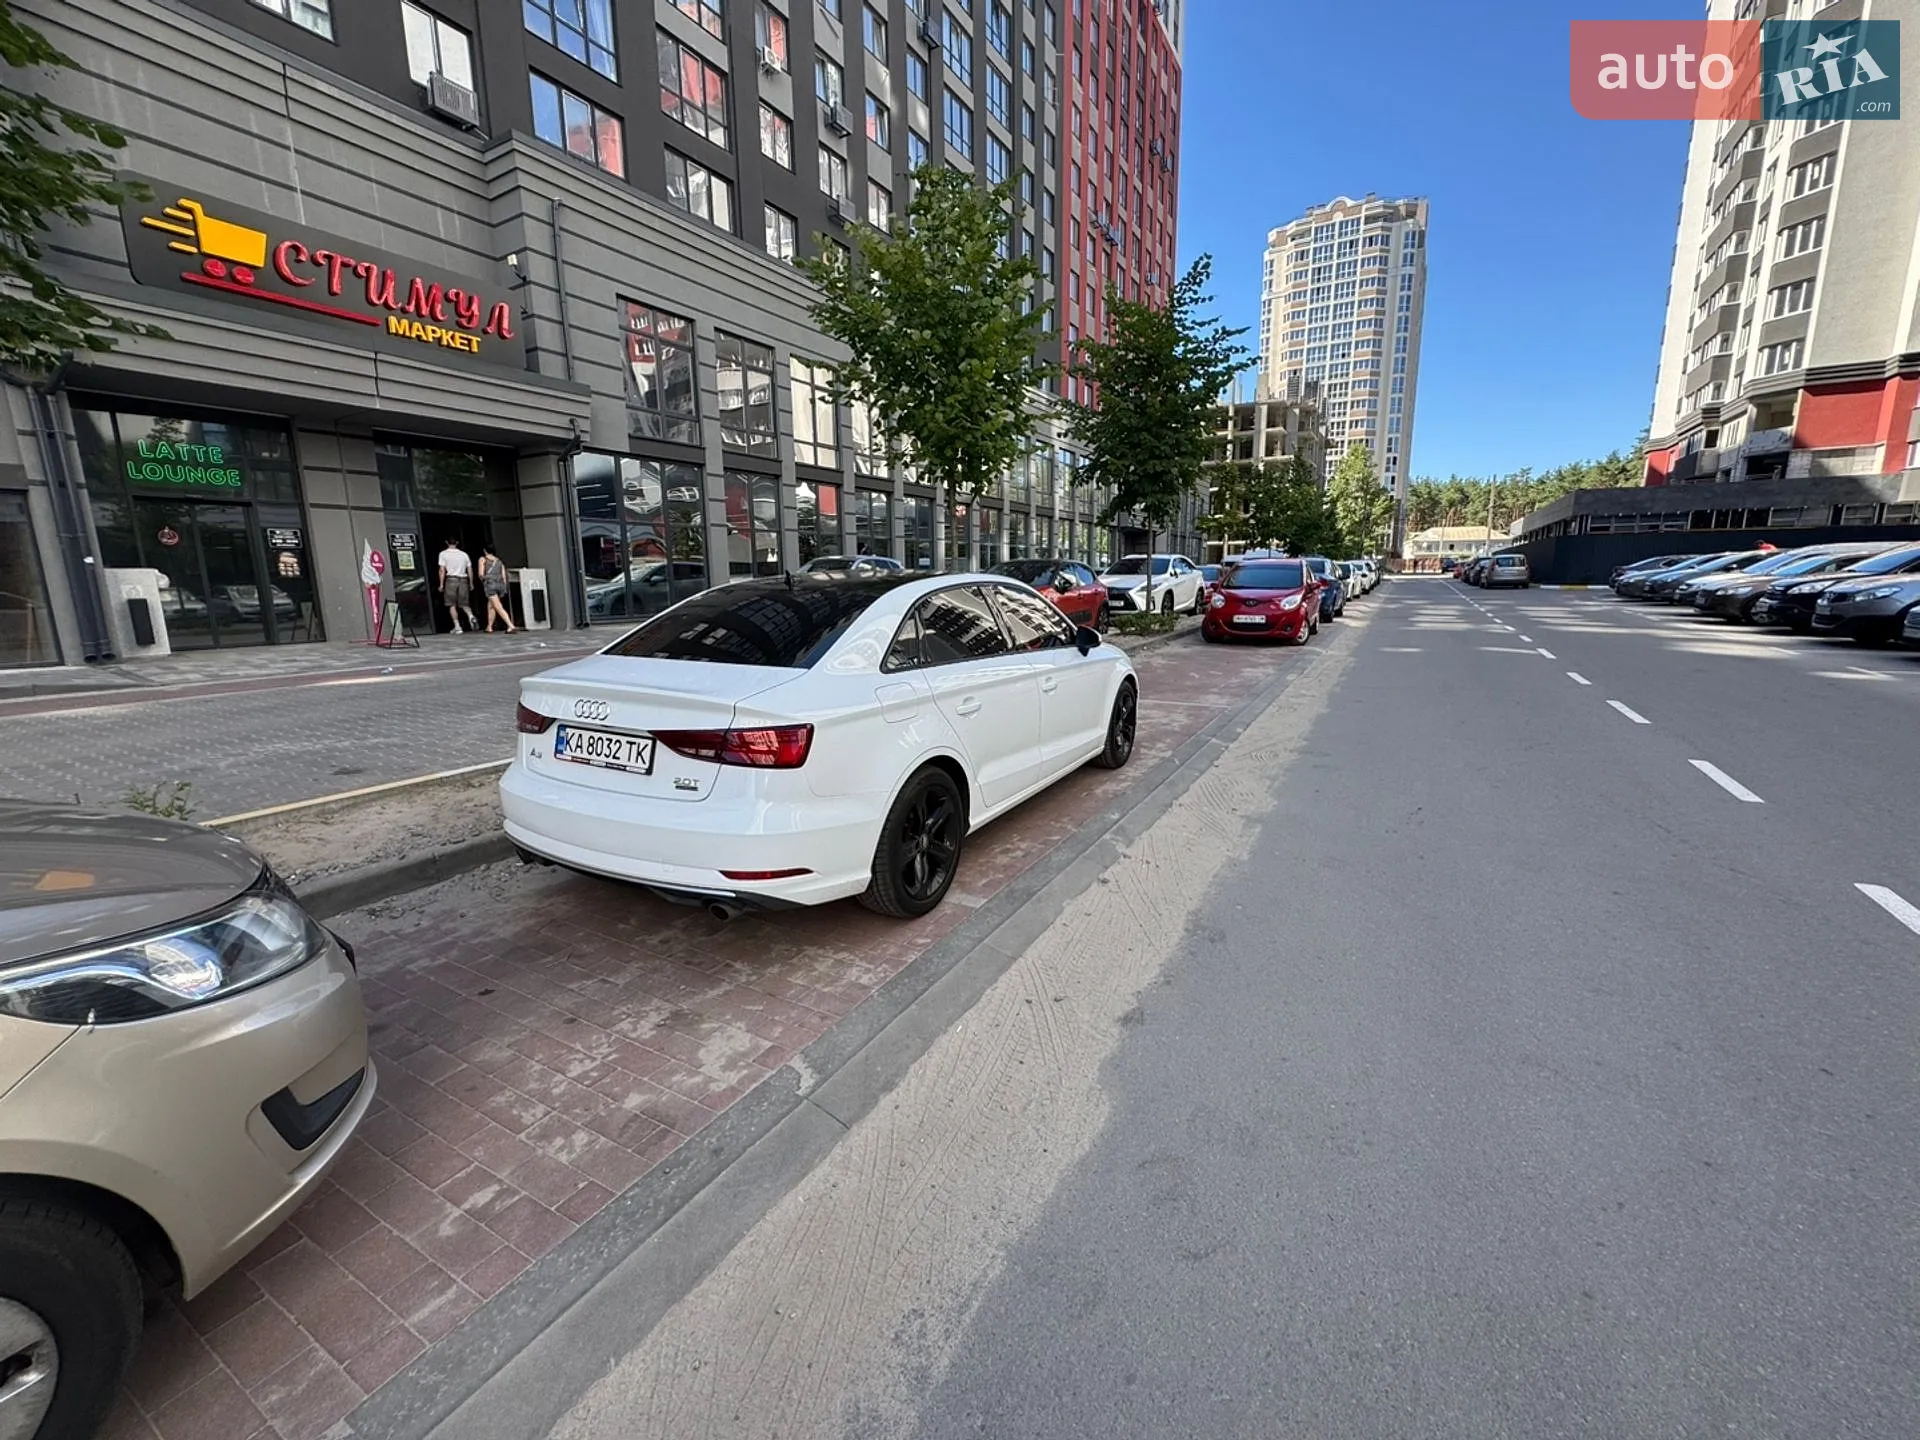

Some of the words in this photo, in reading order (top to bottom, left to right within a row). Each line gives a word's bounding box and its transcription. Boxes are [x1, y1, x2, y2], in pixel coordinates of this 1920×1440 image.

[273, 240, 515, 340] СТИМУЛ
[387, 315, 481, 354] МАРКЕТ
[137, 438, 224, 464] LATTE
[126, 460, 242, 487] LOUNGE
[564, 732, 583, 753] KA
[587, 736, 622, 760] 8032
[626, 741, 649, 765] TK
